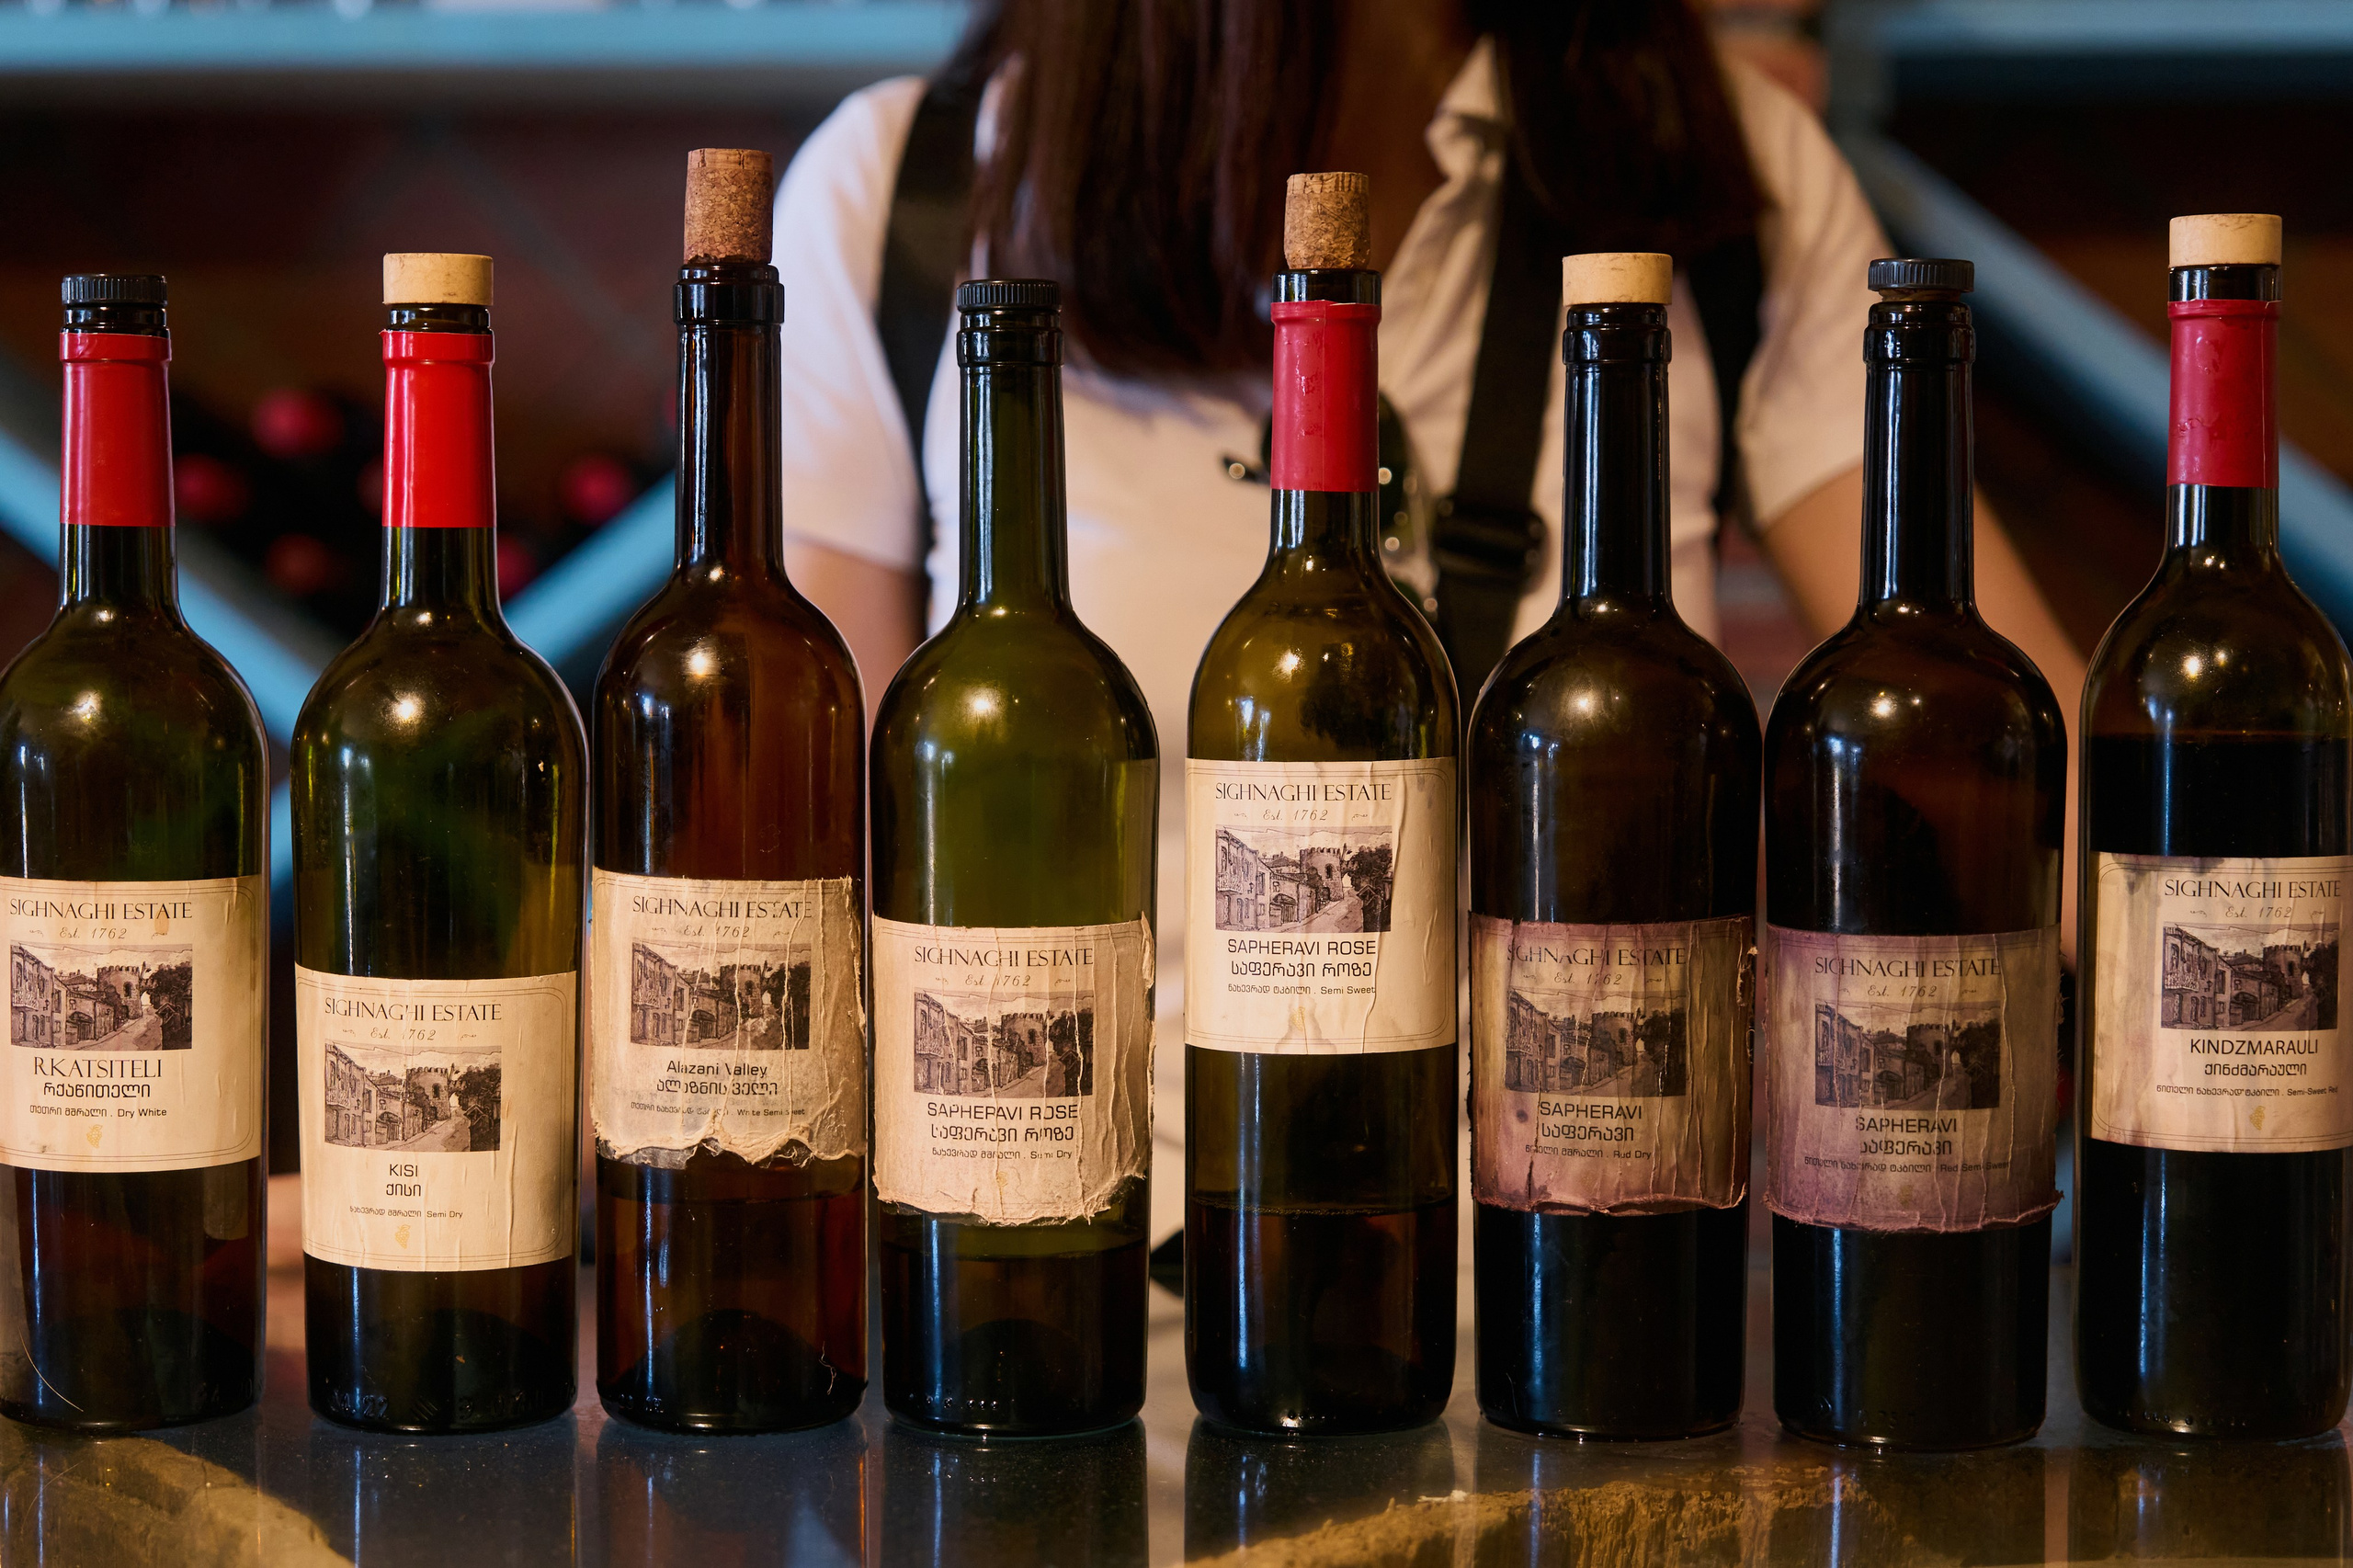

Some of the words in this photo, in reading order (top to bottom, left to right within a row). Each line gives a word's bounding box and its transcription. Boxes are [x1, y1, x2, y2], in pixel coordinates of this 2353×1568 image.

[1215, 782, 1316, 801] SIGHNAGHI
[1324, 783, 1392, 801] ESTATE
[1263, 809, 1283, 821] Est.
[1292, 809, 1329, 822] 1762
[2165, 879, 2281, 899] SIGHNAGHI
[2289, 880, 2341, 899] ESTATE
[10, 898, 114, 919] SIGHNAGHI
[123, 902, 193, 919] ESTATE
[632, 895, 739, 918] SIGHNAGHI
[2225, 906, 2247, 918] Est.
[2258, 906, 2292, 918] 1762
[60, 926, 80, 938] Est.
[91, 928, 127, 939] 1762
[683, 925, 705, 937] Est.
[1227, 938, 1320, 956] SAPHERAVI
[1327, 940, 1377, 956] ROSE
[915, 945, 1018, 967] SIGHNAGHI
[1027, 948, 1094, 967] ESTATE
[1618, 947, 1687, 966] ESTATE
[1231, 960, 1315, 978] საფერავი
[1322, 961, 1372, 978] როზე
[1814, 956, 1926, 978] SIGHNAGHI
[1932, 958, 2002, 978] ESTATE
[995, 974, 1031, 987] 1762
[1553, 971, 1575, 984] Est.
[1228, 983, 1270, 994] ნახევრად
[1273, 985, 1312, 994] ტკბილი
[1320, 985, 1344, 994] Semi
[1347, 985, 1377, 994] Sweet
[1867, 984, 1890, 997] Est.
[1901, 985, 1938, 997] 1762
[324, 997, 425, 1021] SIGHNAGHI
[433, 1003, 502, 1021] ESTATE
[370, 1028, 391, 1040] Est.
[2189, 1039, 2319, 1055] KINDZMARAULI
[34, 1056, 162, 1078] RKATSITELI
[666, 1060, 719, 1074] Alazani
[2204, 1062, 2307, 1076] ქინძმარაული
[44, 1083, 151, 1098] რქაწითელი
[2287, 1087, 2327, 1096] Semi-Sweet
[2328, 1085, 2338, 1094] Red
[29, 1105, 62, 1116] თეთრი
[64, 1108, 108, 1118] მშრალი
[118, 1108, 135, 1119] Dry
[138, 1108, 167, 1117] White
[763, 1108, 783, 1117] Semi
[1540, 1101, 1643, 1119] SAPHERAVI
[1541, 1122, 1634, 1142] საფერავი
[1855, 1117, 1958, 1133] SAPHERAVI
[1056, 1149, 1073, 1159] Dry
[1561, 1147, 1603, 1158] მშრალი
[1634, 1150, 1652, 1161] Dry
[390, 1164, 418, 1177] KISI
[1939, 1164, 1959, 1172] Red
[386, 1183, 422, 1197] ქისი
[388, 1209, 422, 1218] მშრალი
[449, 1210, 463, 1220] Dry
